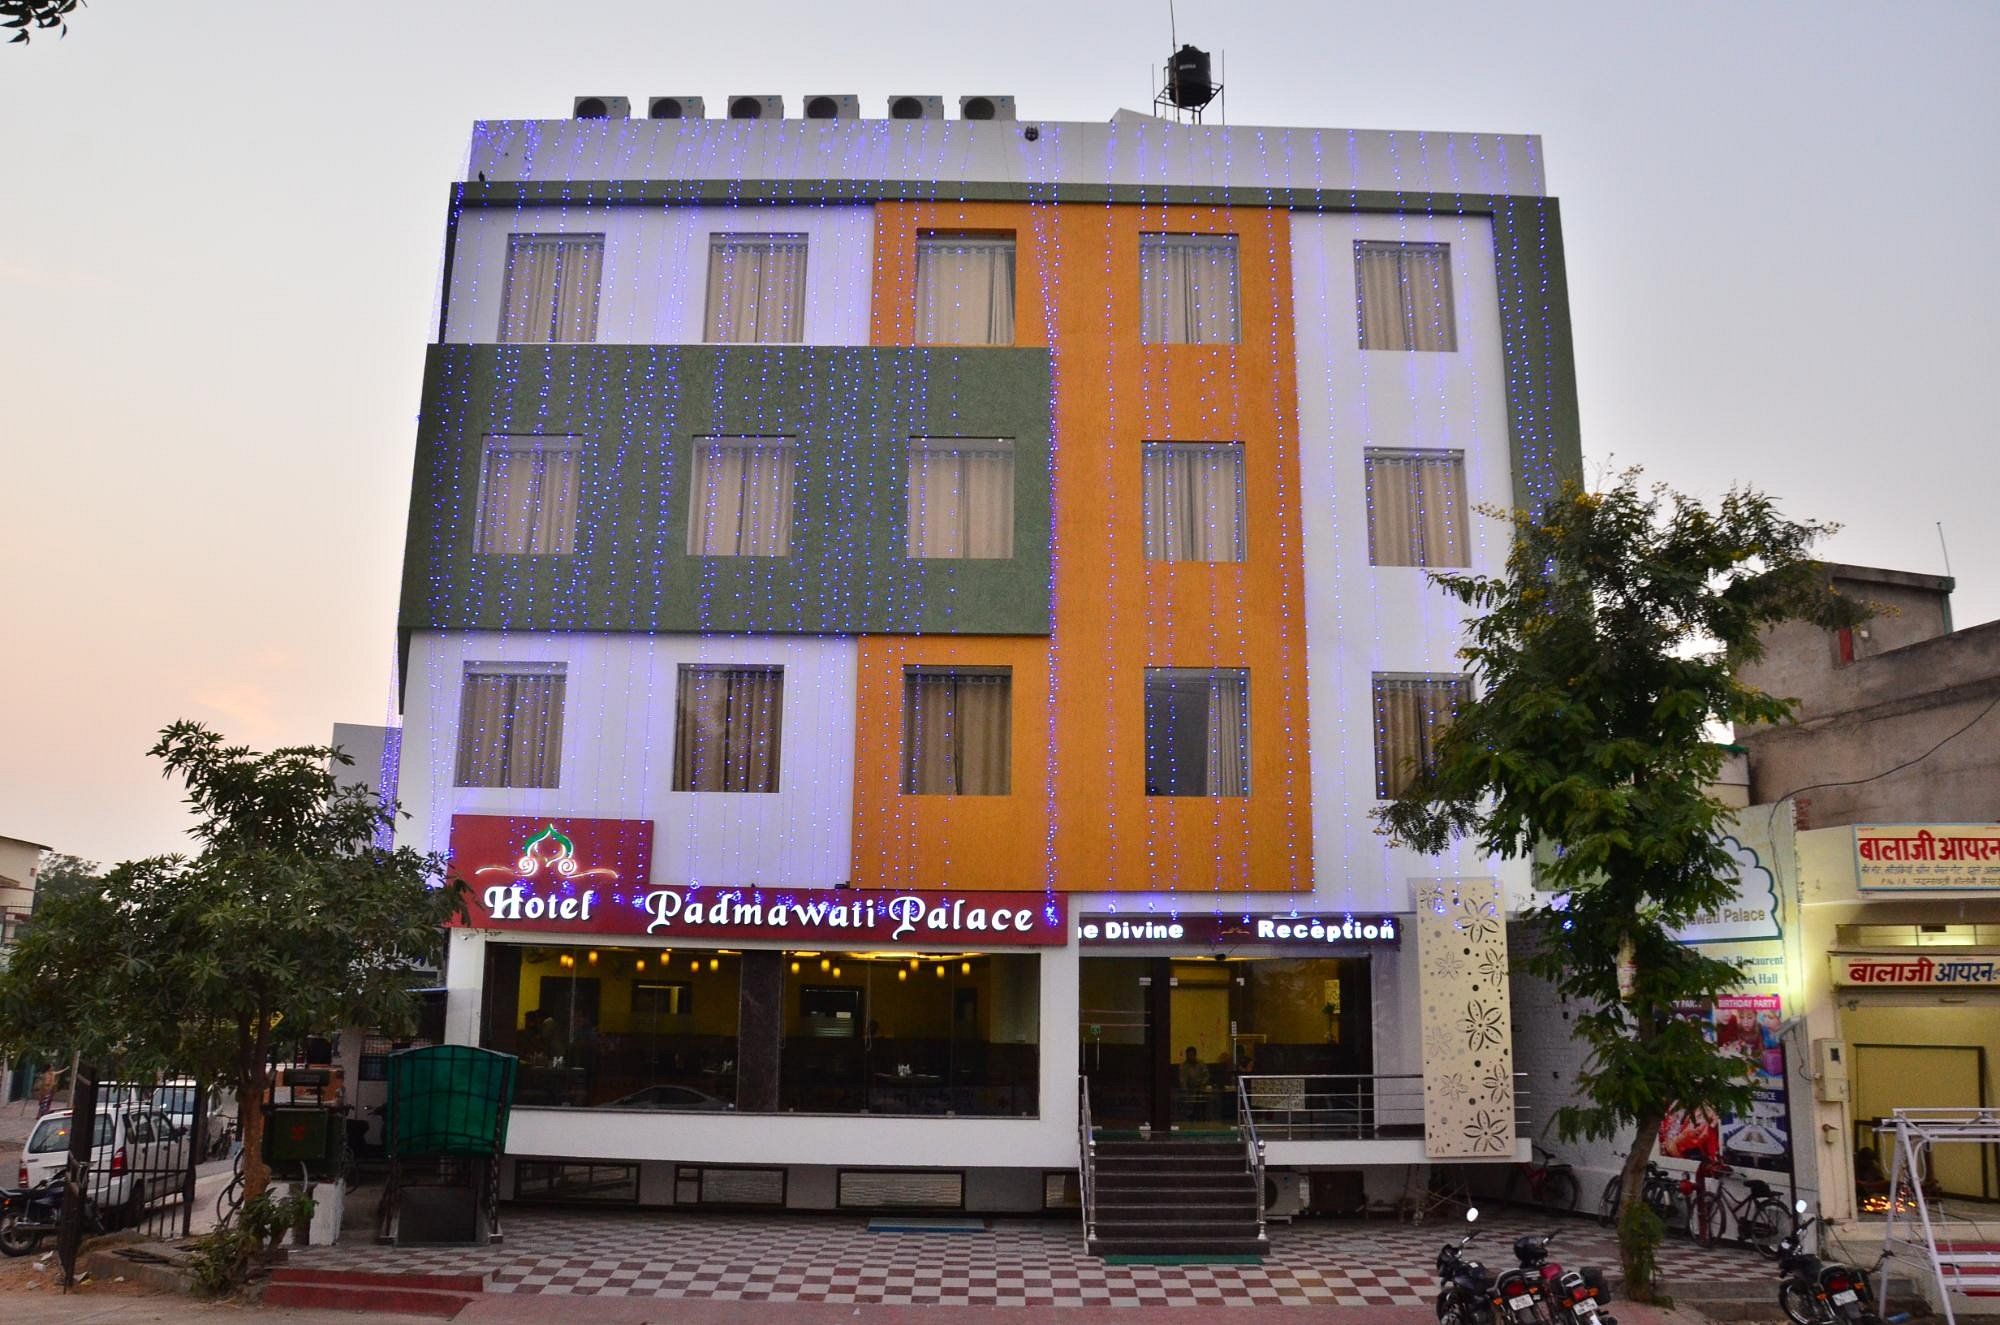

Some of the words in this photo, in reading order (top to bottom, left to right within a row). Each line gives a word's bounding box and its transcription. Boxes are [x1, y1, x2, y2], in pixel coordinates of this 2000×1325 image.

[1857, 829, 1936, 861] बालाजी
[484, 886, 594, 920] Hotel
[645, 890, 876, 934] Padmawati
[888, 896, 1033, 940] Palace
[1724, 908, 1766, 923] Palace
[1105, 921, 1184, 939] Divine
[1258, 920, 1395, 942] Reception
[1759, 973, 1778, 984] Hall
[1848, 957, 1935, 982] बालाजी
[1935, 963, 1994, 982] आयरन
[1718, 999, 1752, 1008] BIRTHDAY
[1753, 998, 1777, 1008] PARTY
